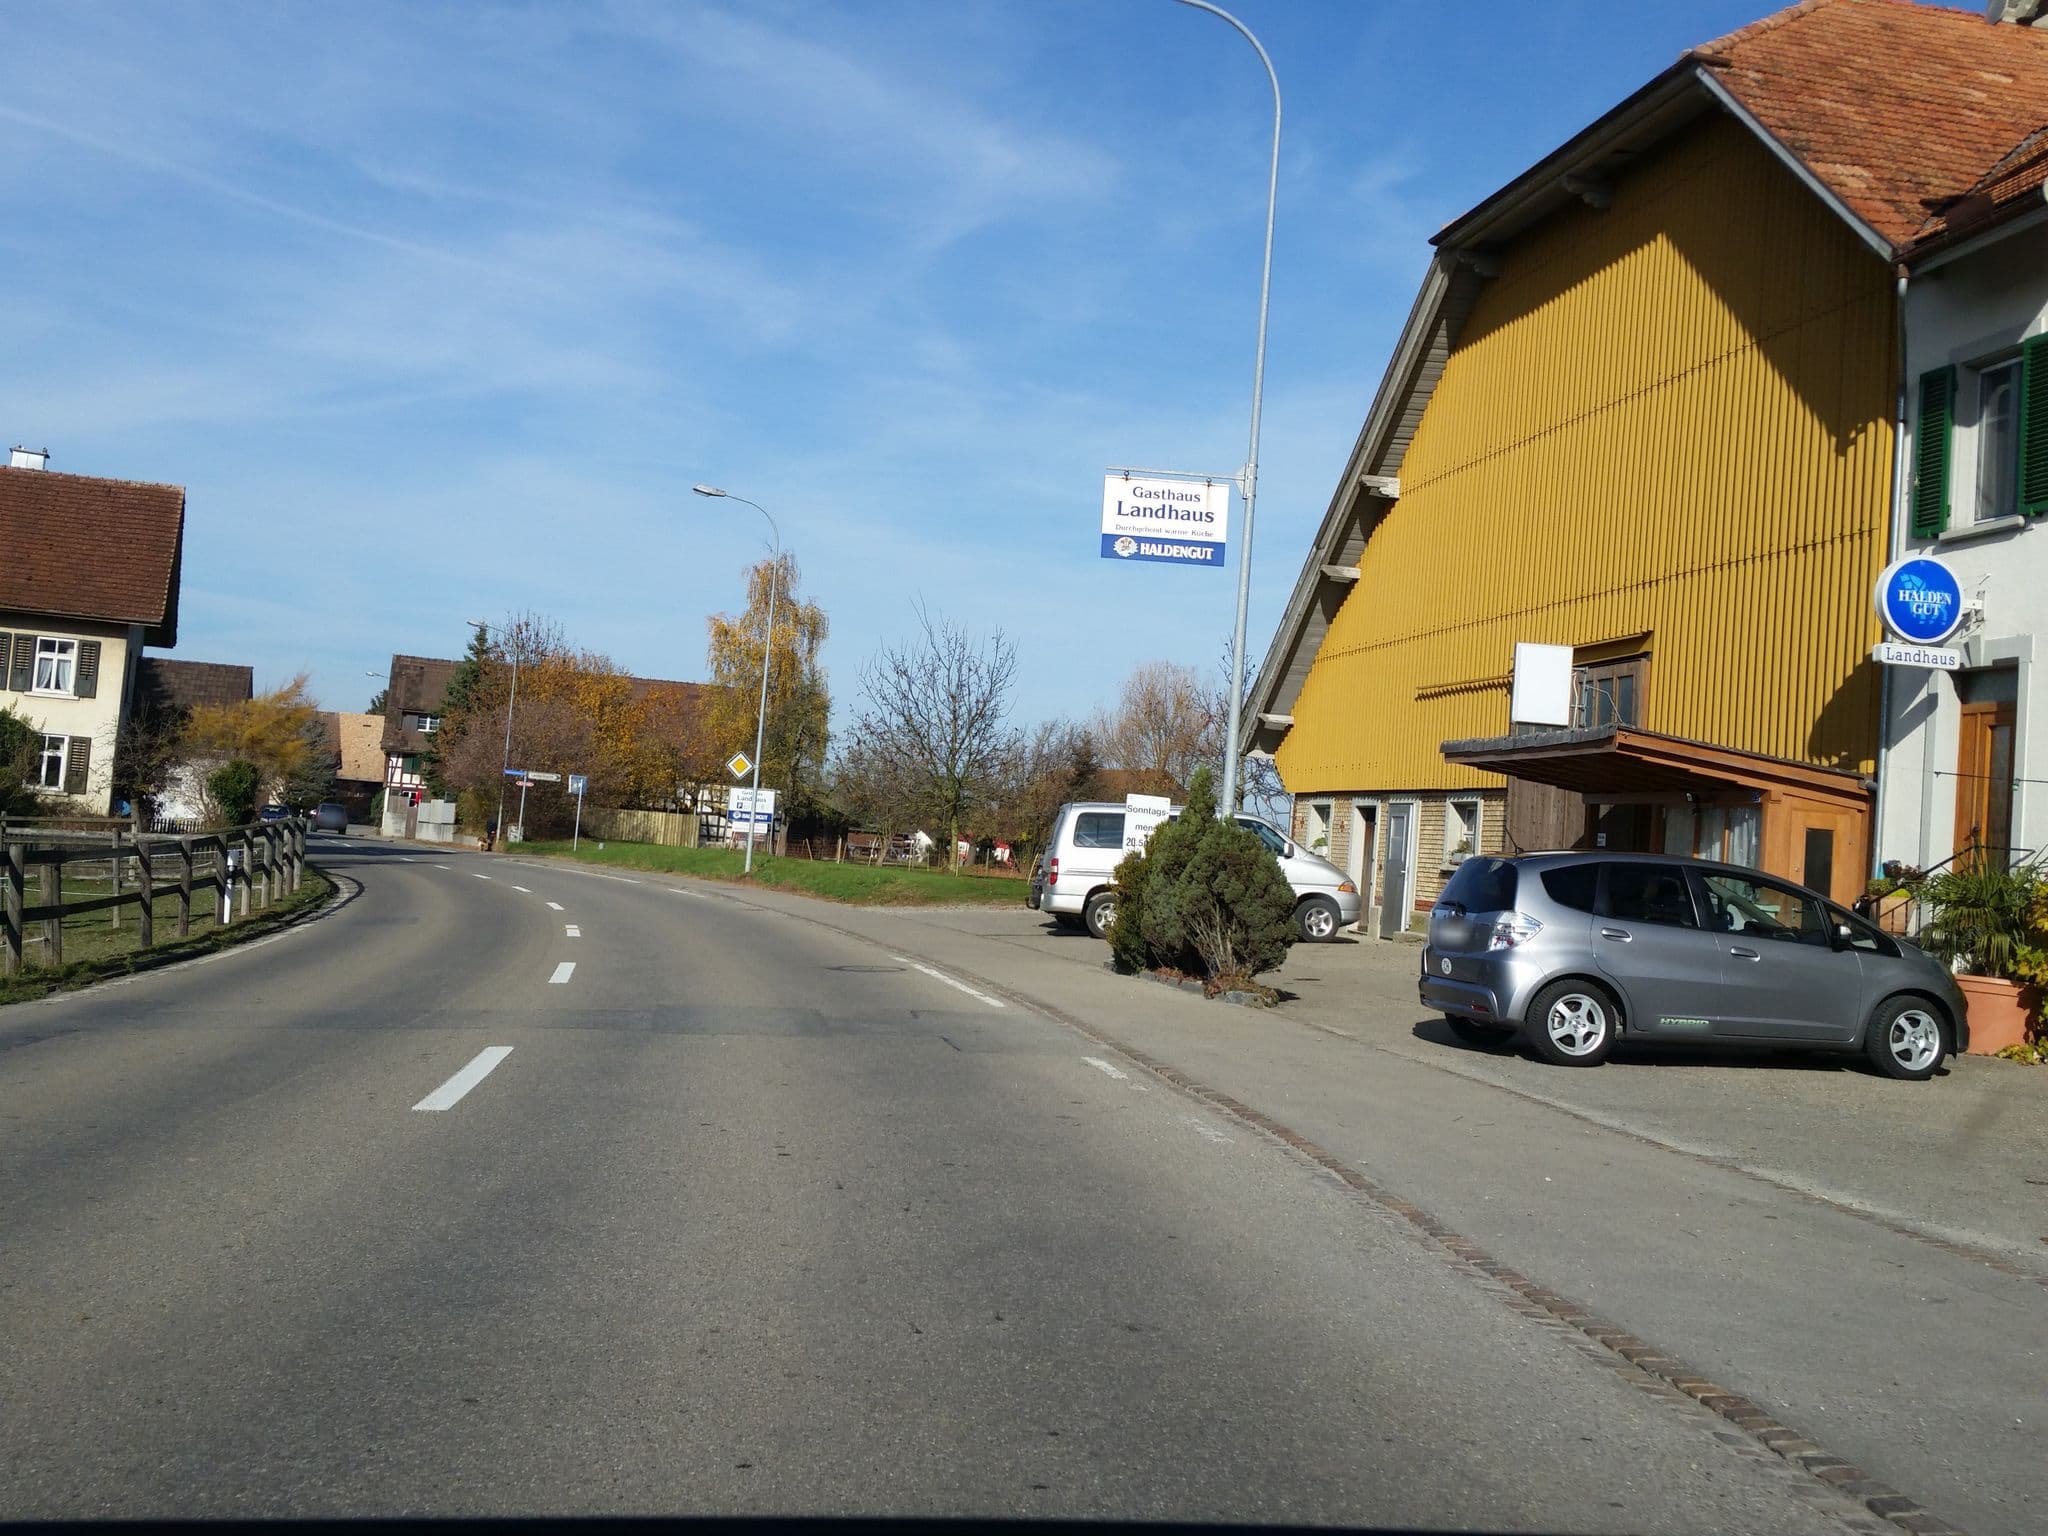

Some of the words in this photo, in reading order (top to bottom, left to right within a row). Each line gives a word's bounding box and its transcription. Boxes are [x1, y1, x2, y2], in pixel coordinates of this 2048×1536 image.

[1132, 486, 1201, 503] Gasthaus
[1117, 500, 1215, 523] Landhaus
[1140, 542, 1214, 560] HALDENGUT
[1898, 589, 1952, 606] HALDEN
[1912, 602, 1940, 616] GUT
[1886, 646, 1956, 666] Landhaus
[1127, 804, 1169, 817] Sonntags-
